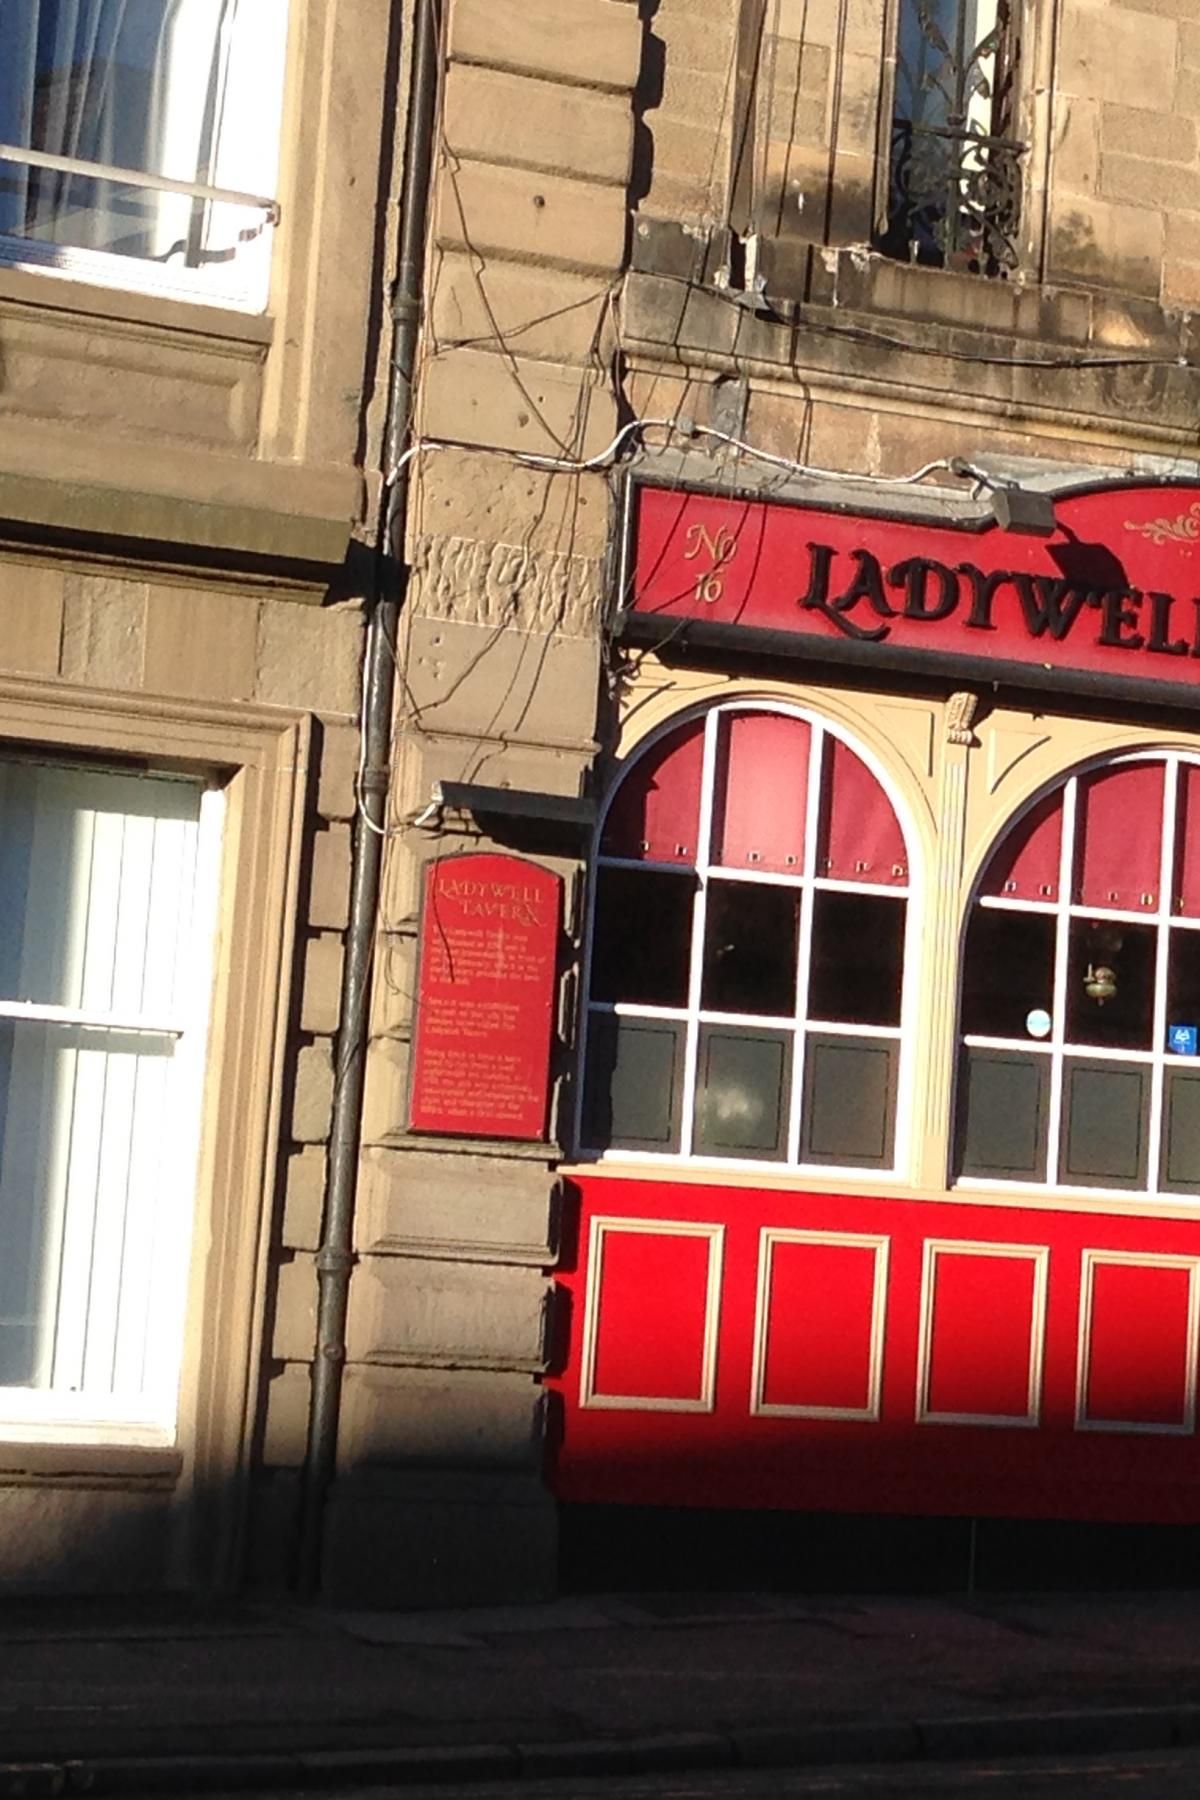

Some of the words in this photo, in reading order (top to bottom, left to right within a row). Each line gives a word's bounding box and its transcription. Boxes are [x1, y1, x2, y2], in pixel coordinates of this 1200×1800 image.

[694, 567, 725, 602] 16
[437, 876, 545, 905] LADYWELL
[458, 900, 548, 928] TAVERN
